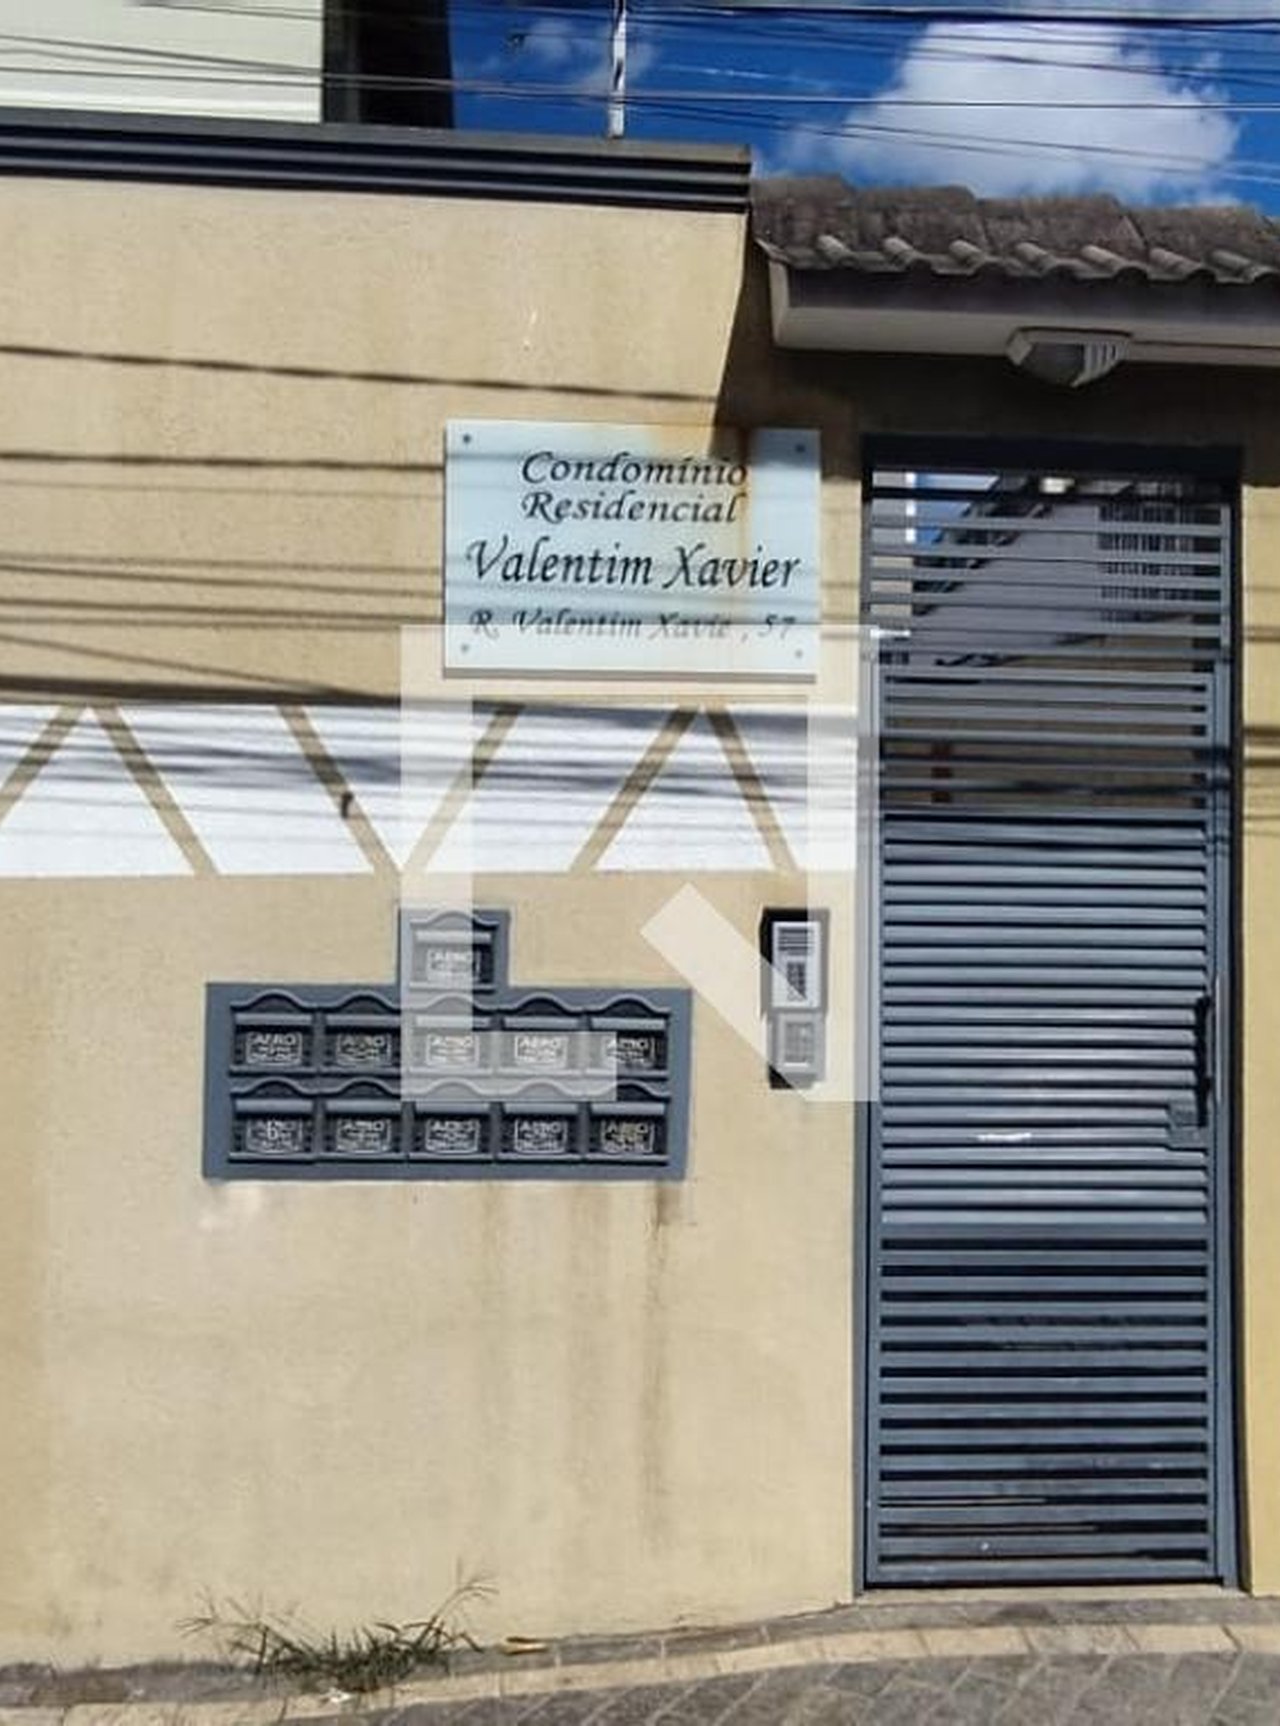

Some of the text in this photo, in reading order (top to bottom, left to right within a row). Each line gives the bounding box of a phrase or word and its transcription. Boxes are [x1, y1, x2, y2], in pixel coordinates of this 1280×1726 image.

[521, 451, 748, 486] Condomínio
[521, 489, 747, 525] Residencial
[466, 534, 802, 589] Valentim Xavier
[513, 606, 642, 638] Valentim
[757, 613, 797, 641] 57
